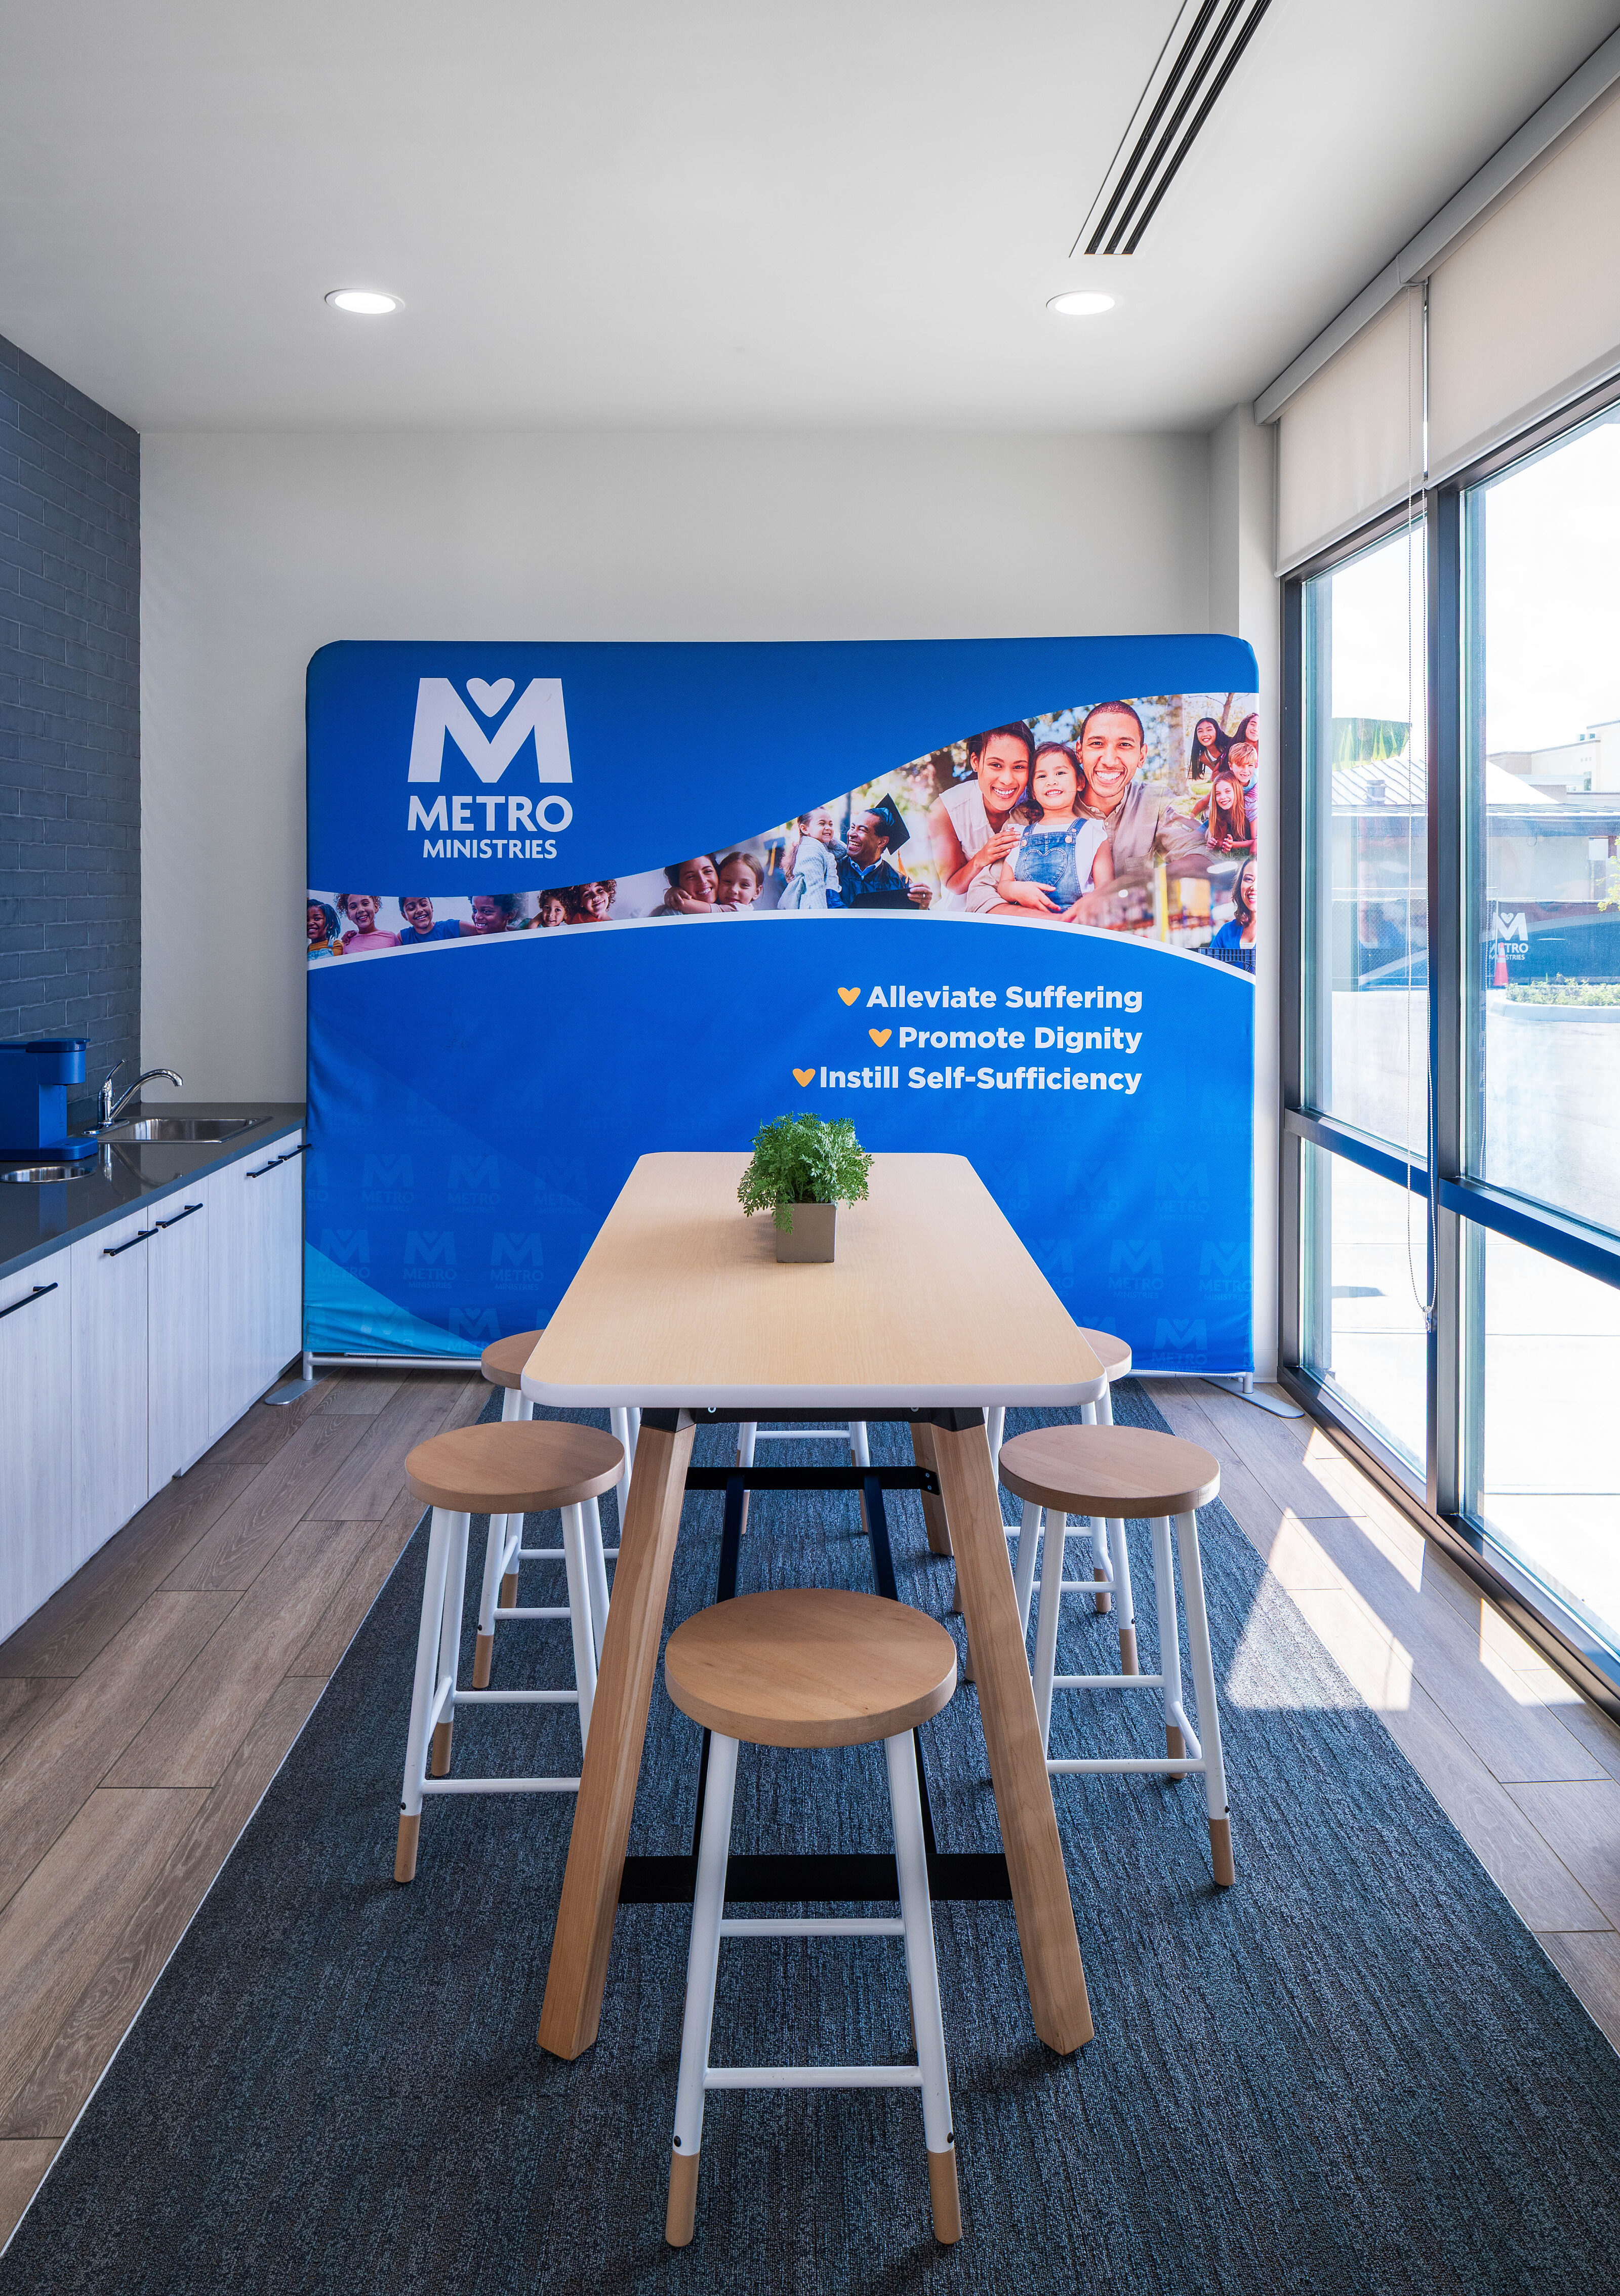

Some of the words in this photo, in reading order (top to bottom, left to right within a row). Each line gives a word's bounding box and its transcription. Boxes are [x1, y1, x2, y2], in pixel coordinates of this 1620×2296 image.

[408, 795, 573, 832] METRO
[423, 839, 557, 859] MINISTRIES
[866, 986, 997, 1008] Alleviate
[1005, 985, 1143, 1013] Suffering
[899, 1027, 1025, 1049] Promote
[1035, 1027, 1143, 1054] Dignity
[820, 1066, 899, 1088] Instill
[908, 1066, 1143, 1095] Self-Sufficiency
[361, 1191, 415, 1204] METRO
[448, 1193, 501, 1205] METRO
[1154, 1200, 1210, 1213] METRO
[317, 1266, 371, 1280] METRO
[403, 1268, 458, 1281] METRO
[490, 1268, 544, 1282] METRO
[1108, 1277, 1164, 1290] METRO
[1151, 1352, 1208, 1365] METRO
